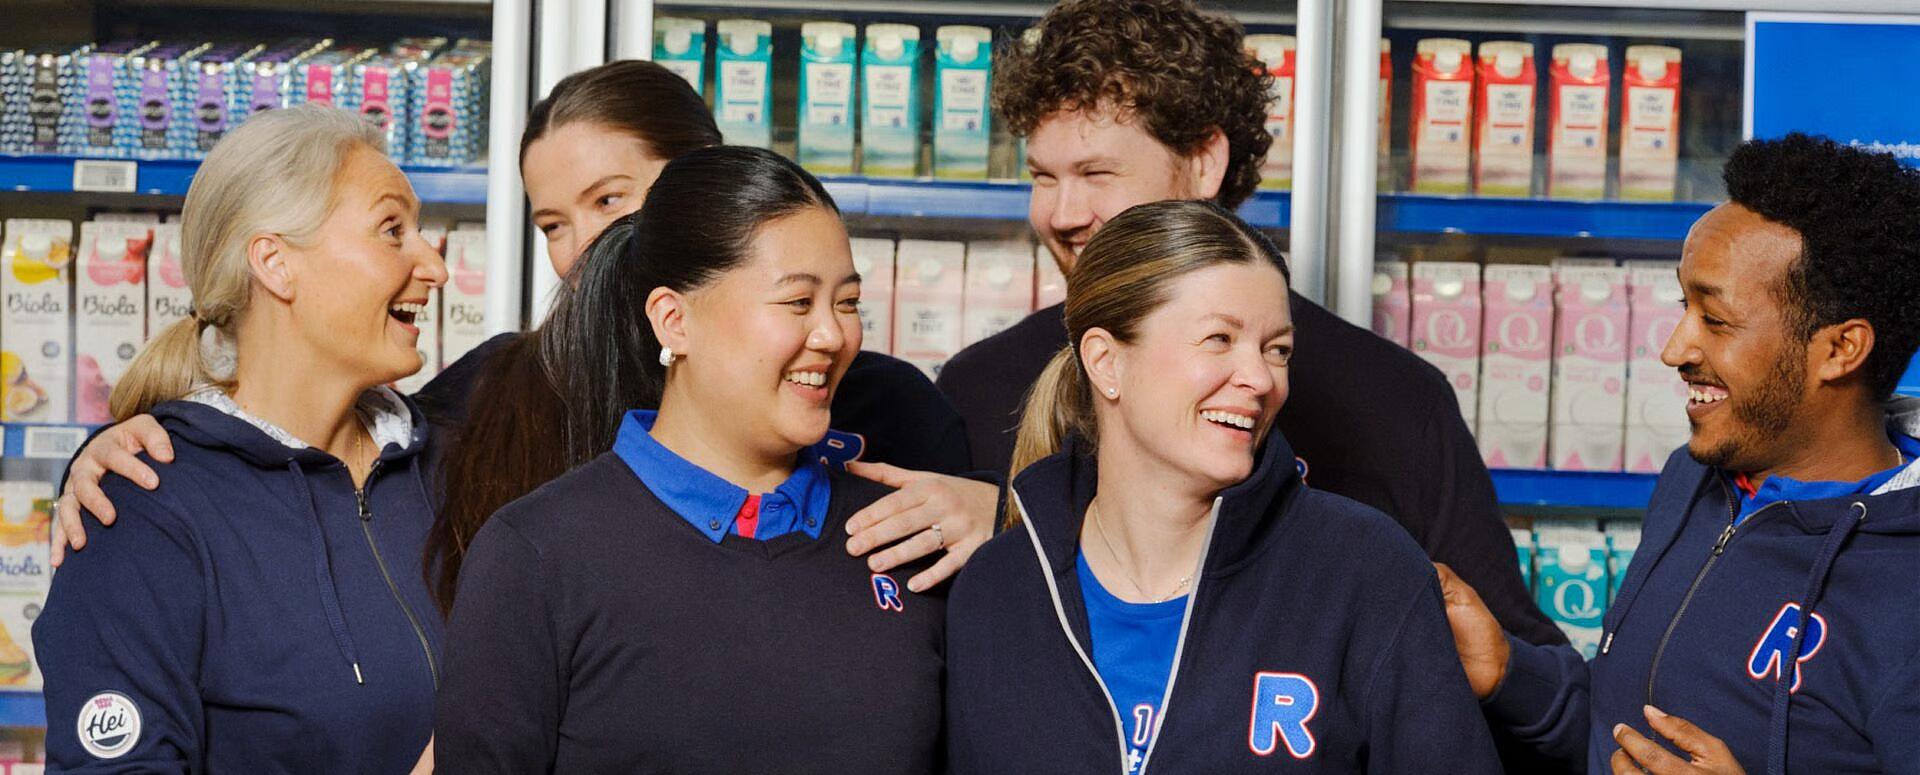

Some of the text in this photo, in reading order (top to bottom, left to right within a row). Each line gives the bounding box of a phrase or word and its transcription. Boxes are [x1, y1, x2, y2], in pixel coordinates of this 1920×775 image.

[8, 293, 62, 314] Biola
[83, 294, 138, 316] Biola
[155, 297, 194, 317] Bio
[450, 303, 484, 325] Bio
[1427, 309, 1474, 348] Q
[1501, 312, 1545, 350] Q
[1575, 313, 1622, 352] Q
[0, 556, 42, 576] iola
[871, 573, 904, 612] R
[1553, 579, 1601, 619] Q
[1746, 601, 1828, 695] R
[86, 708, 127, 739] Hei
[1248, 671, 1320, 759] R
